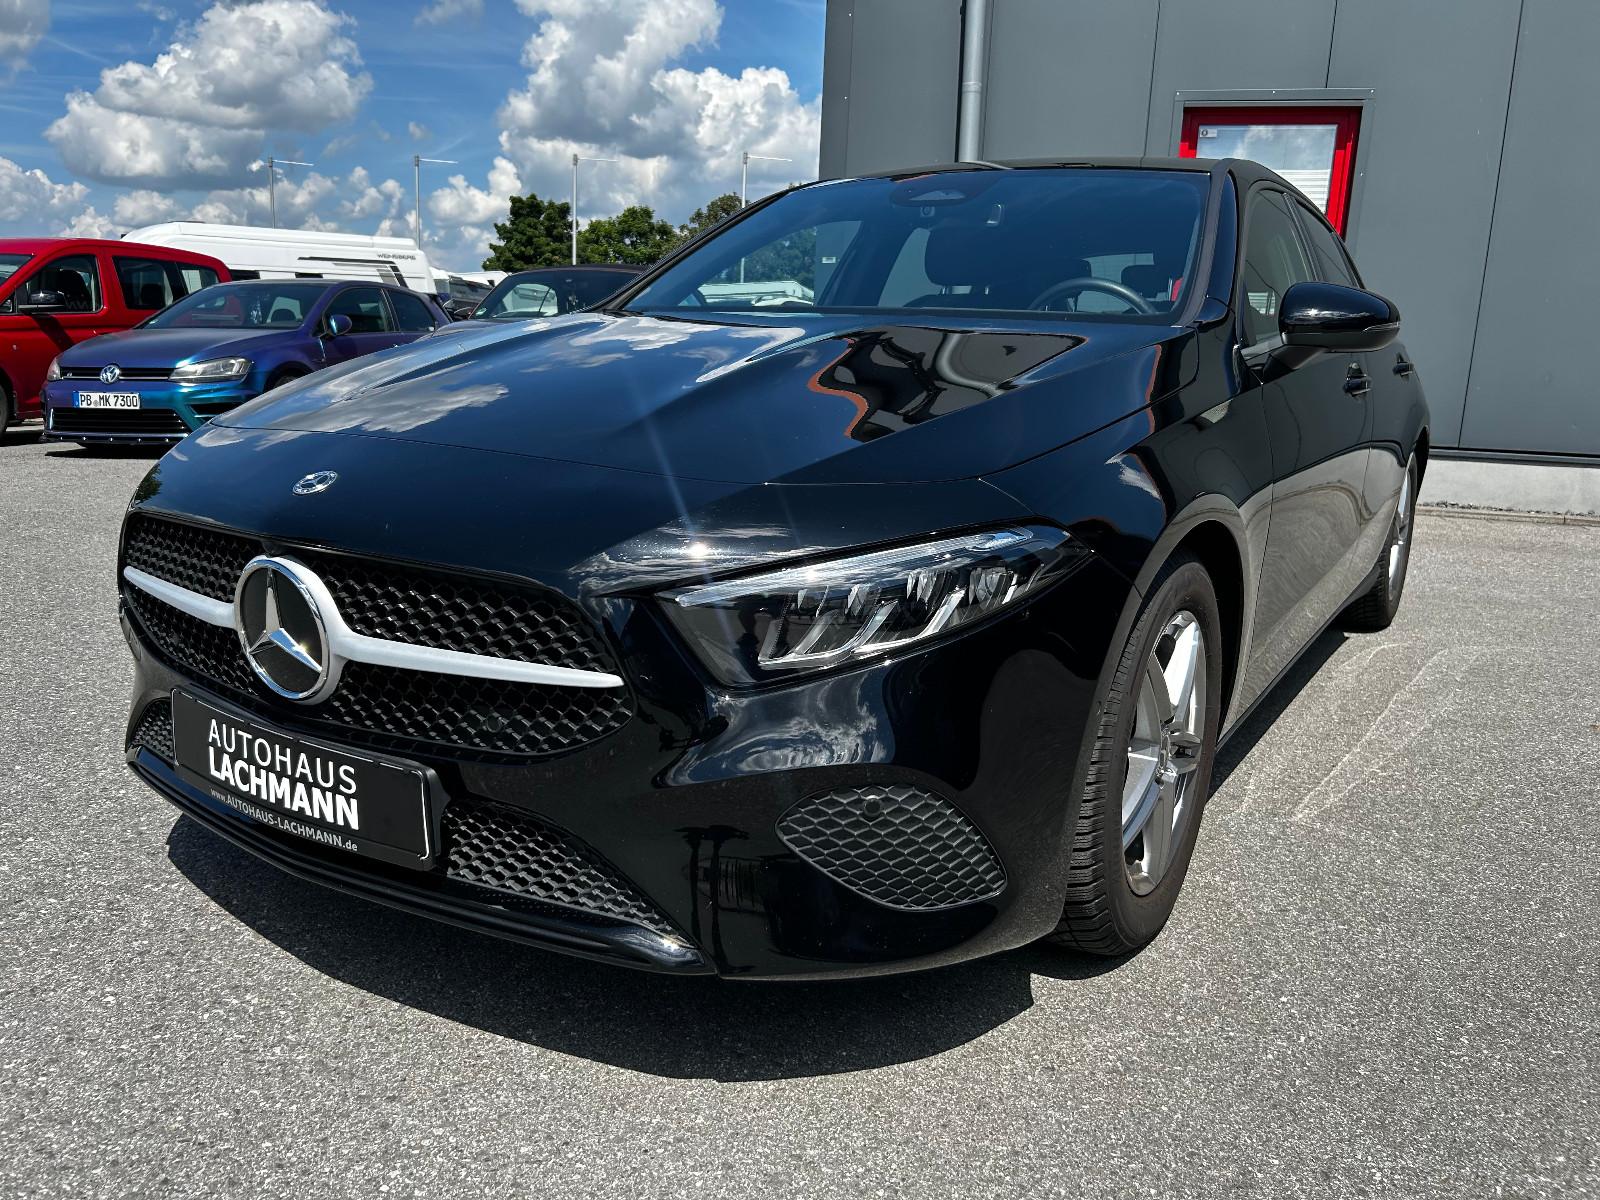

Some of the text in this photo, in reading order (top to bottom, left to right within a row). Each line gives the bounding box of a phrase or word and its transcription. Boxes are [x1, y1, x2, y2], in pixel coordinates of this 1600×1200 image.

[79, 394, 138, 407] PB MK 7300
[208, 719, 357, 794] AUTOHAUS
[208, 746, 359, 830] LACHMANN
[210, 788, 358, 851] www.AUTOHAUS-LACHMANN.de
